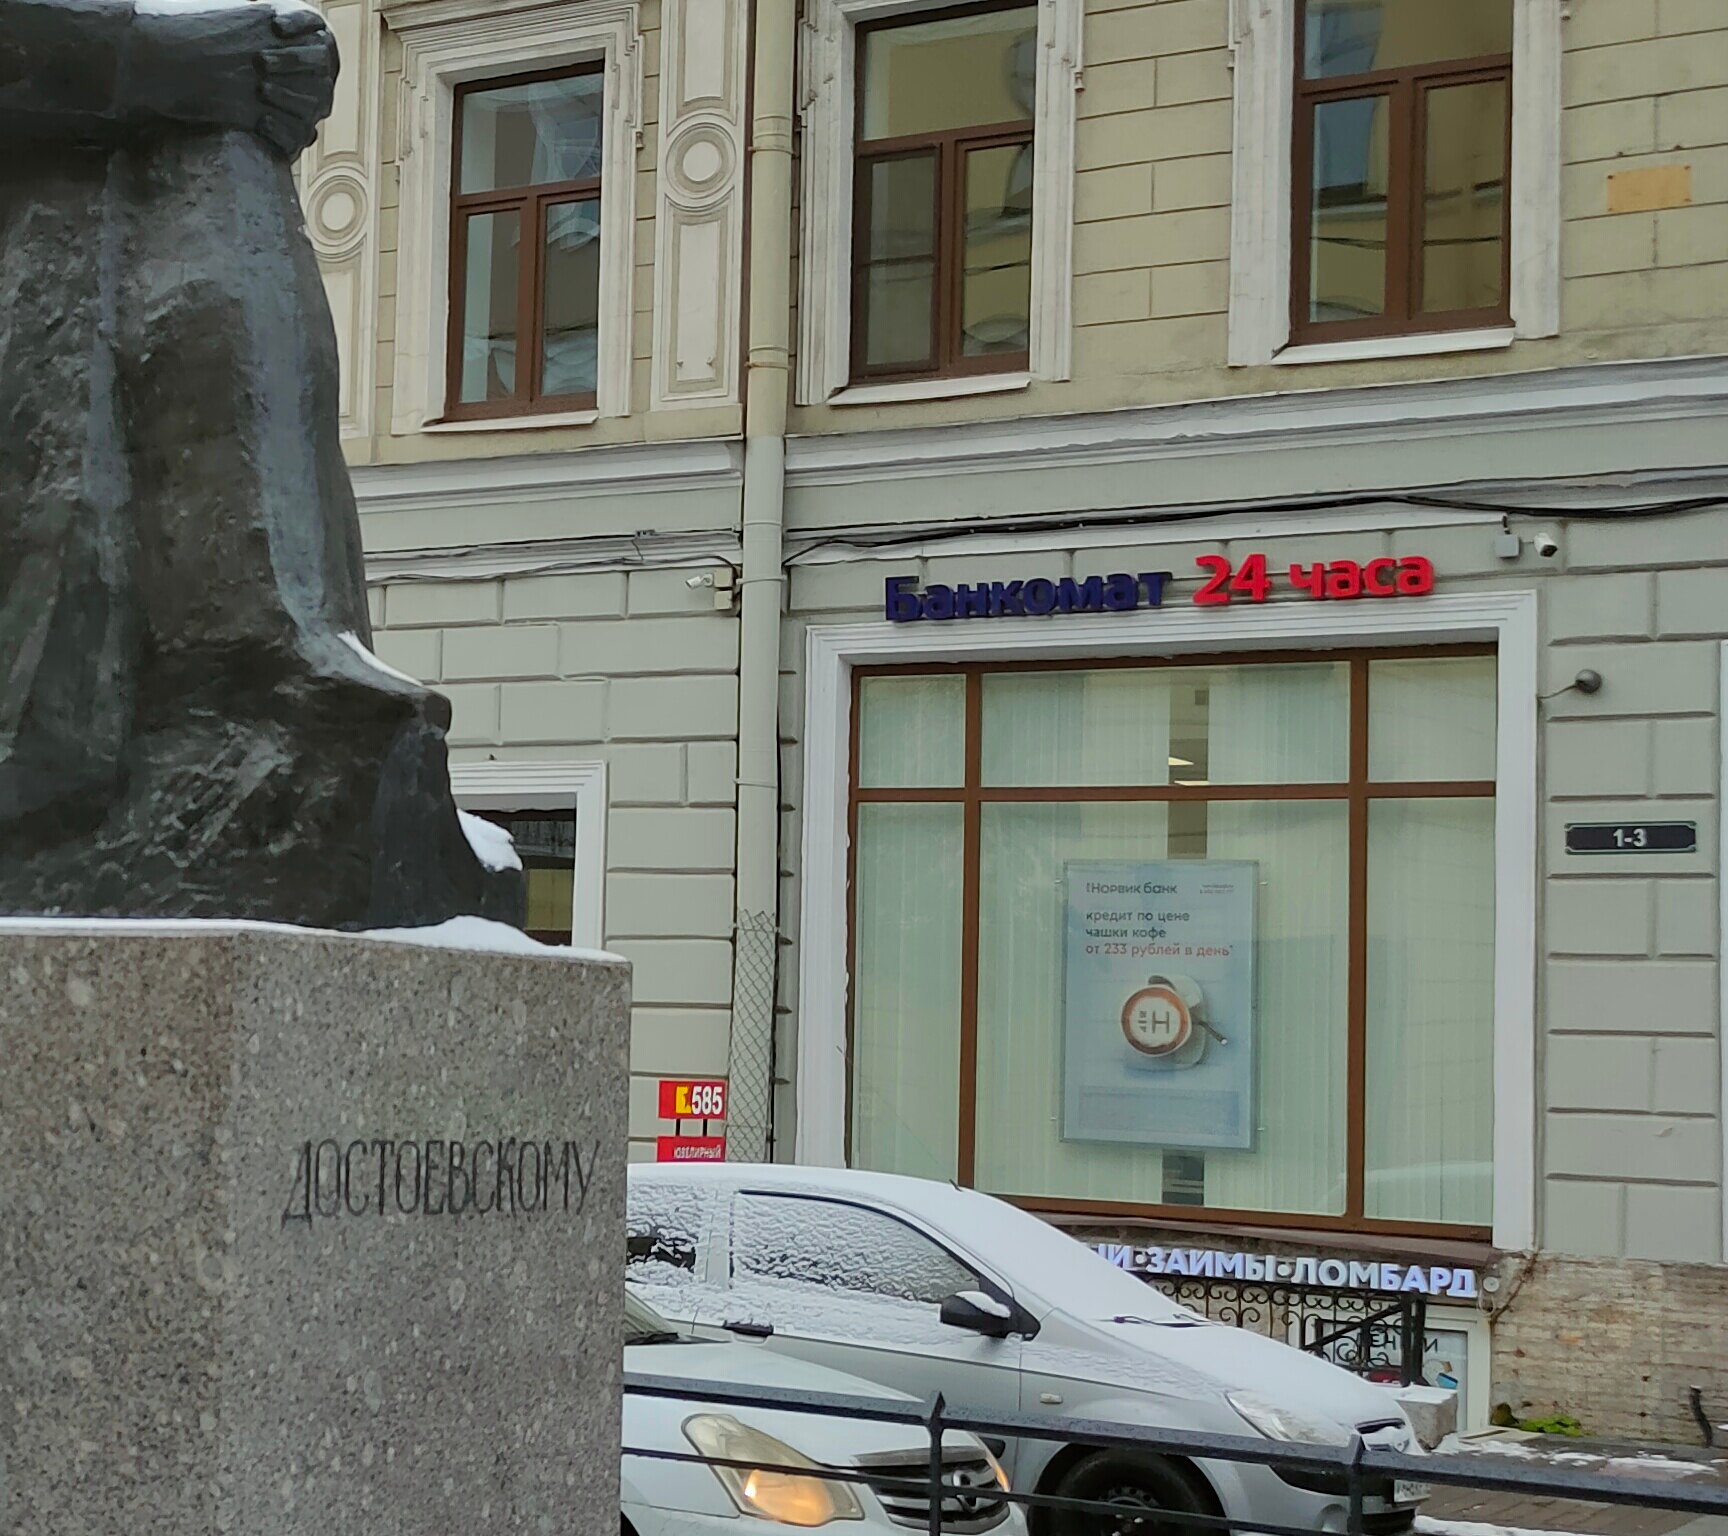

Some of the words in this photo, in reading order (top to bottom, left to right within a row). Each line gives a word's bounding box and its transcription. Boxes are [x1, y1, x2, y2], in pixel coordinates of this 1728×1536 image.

[884, 571, 1173, 622] Банкомат
[1193, 554, 1271, 605] 24
[1289, 555, 1435, 600] часа
[1613, 828, 1647, 847] 1-3
[1143, 882, 1177, 894] банк
[1086, 912, 1133, 923] кредит
[1158, 913, 1191, 922] цене
[1086, 928, 1129, 938] чашки
[1132, 927, 1167, 940] кофе
[1085, 946, 1100, 955] от
[1104, 943, 1128, 955] 233
[1131, 943, 1181, 958] рублей
[1184, 947, 1193, 956] в
[692, 1086, 723, 1115] 585
[281, 1137, 600, 1231] ДОСТОЕВСКОМУ
[1291, 1257, 1477, 1297] ЛОМБАРД
